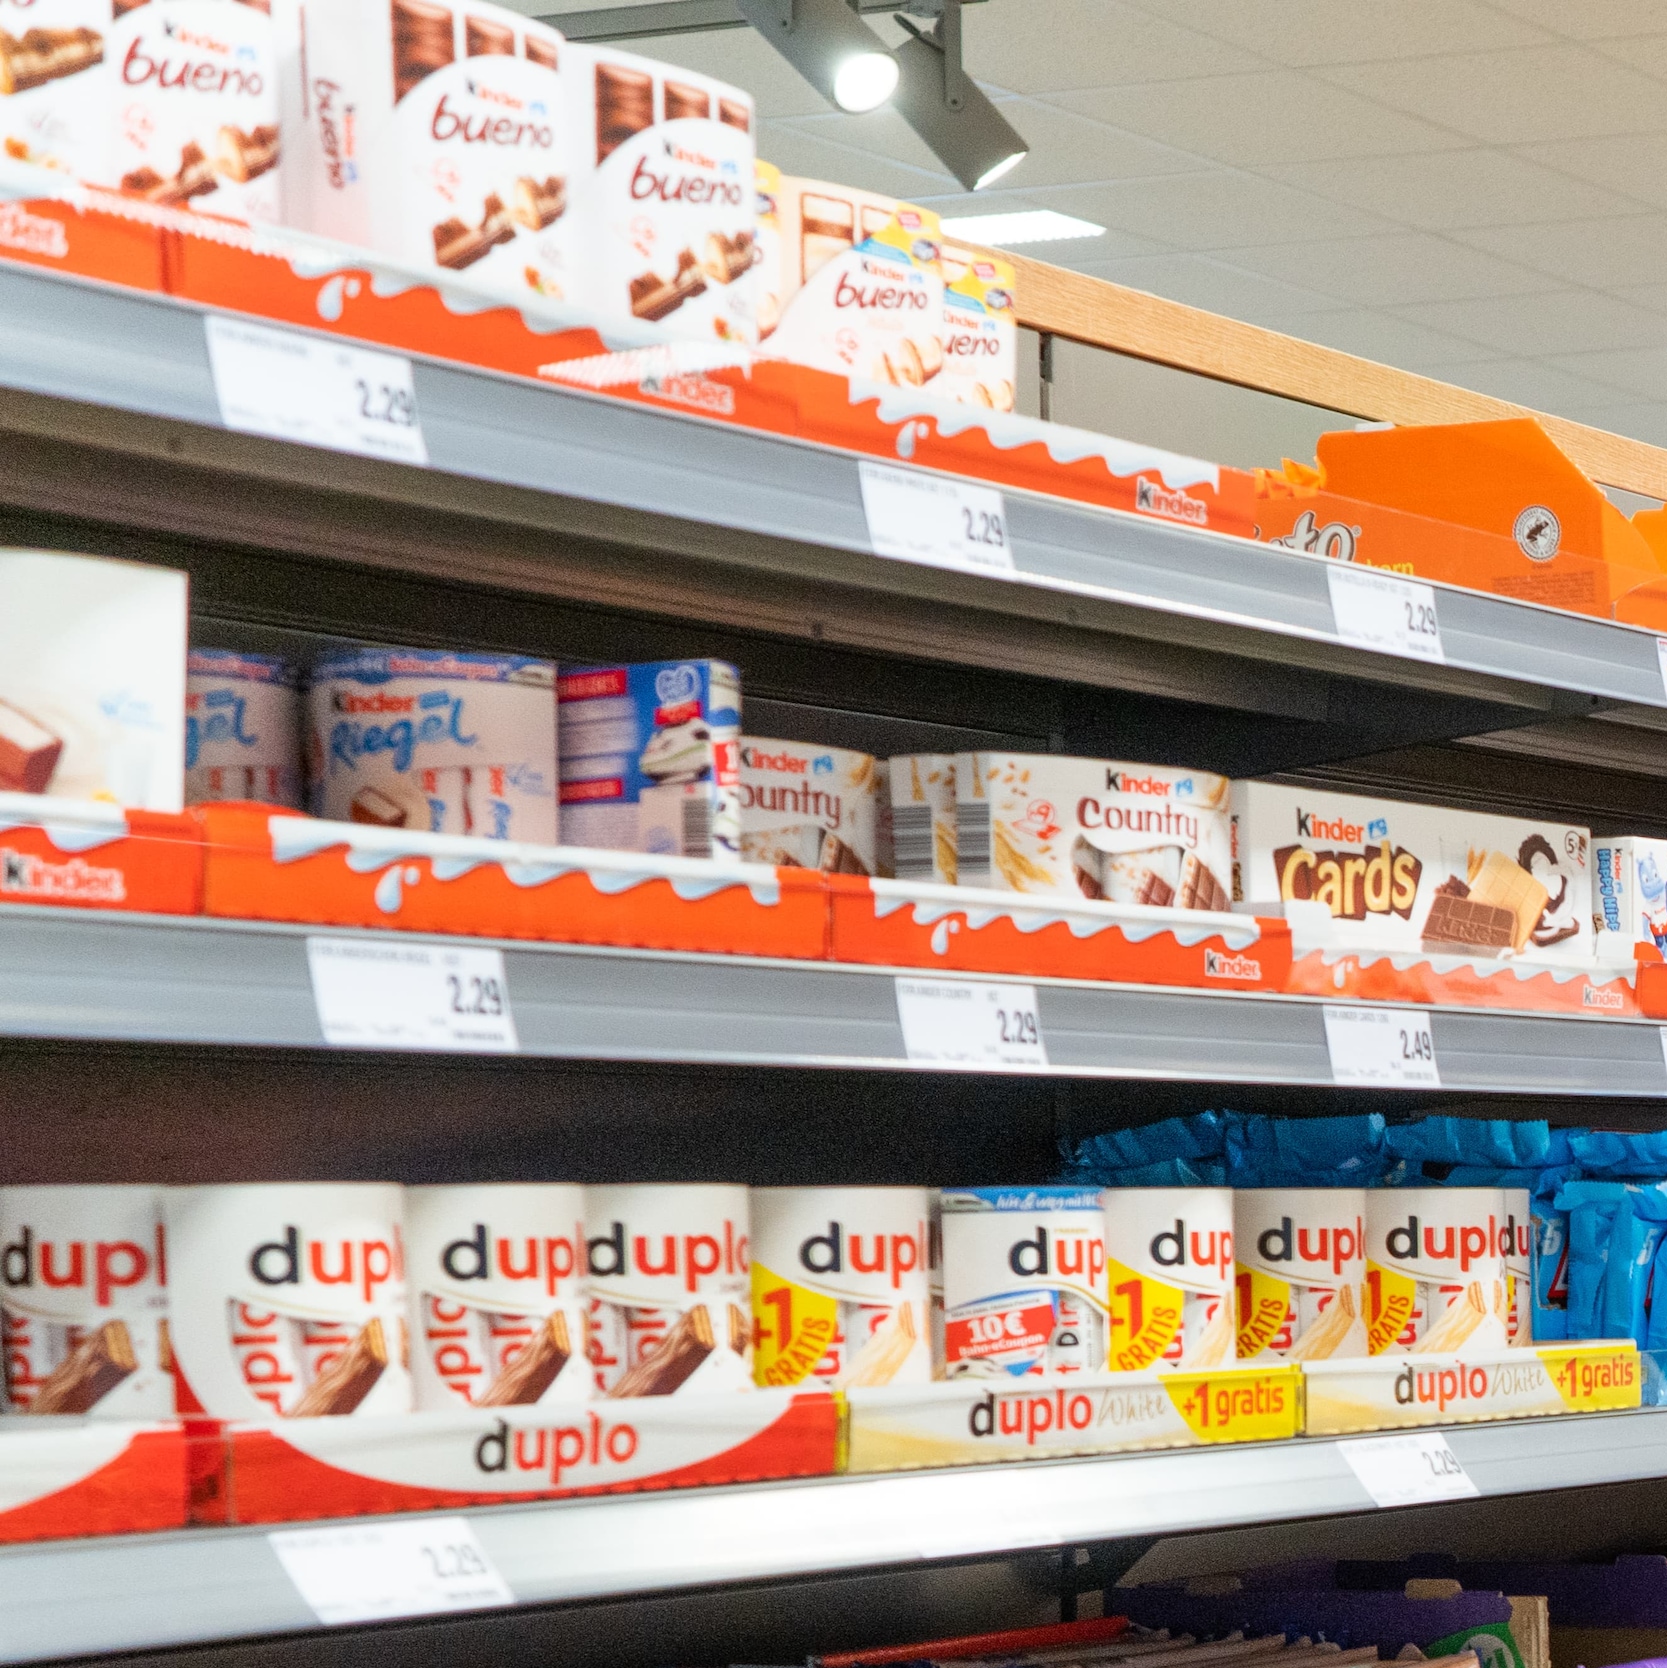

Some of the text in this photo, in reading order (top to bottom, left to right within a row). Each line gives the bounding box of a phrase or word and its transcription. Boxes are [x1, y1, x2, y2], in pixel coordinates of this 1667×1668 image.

[122, 35, 262, 97] bueno
[431, 94, 552, 150] bueno
[630, 155, 742, 205] bueno
[834, 278, 928, 311] bueno
[355, 380, 414, 428] 2.29
[961, 508, 1004, 547] 2.29
[1405, 600, 1437, 636] 2.29
[1076, 797, 1198, 849] Country
[1280, 841, 1419, 916] Cards
[449, 976, 504, 1018] 2.29
[997, 1009, 1038, 1045] 2.29
[1400, 1029, 1432, 1061] 2.49
[1395, 1362, 1488, 1411] duplo
[1580, 1355, 1635, 1396] gratis
[969, 1389, 1094, 1444] duplo
[1214, 1377, 1284, 1428] gratis
[476, 1418, 638, 1484] duplo
[1422, 1451, 1462, 1477] 2.29
